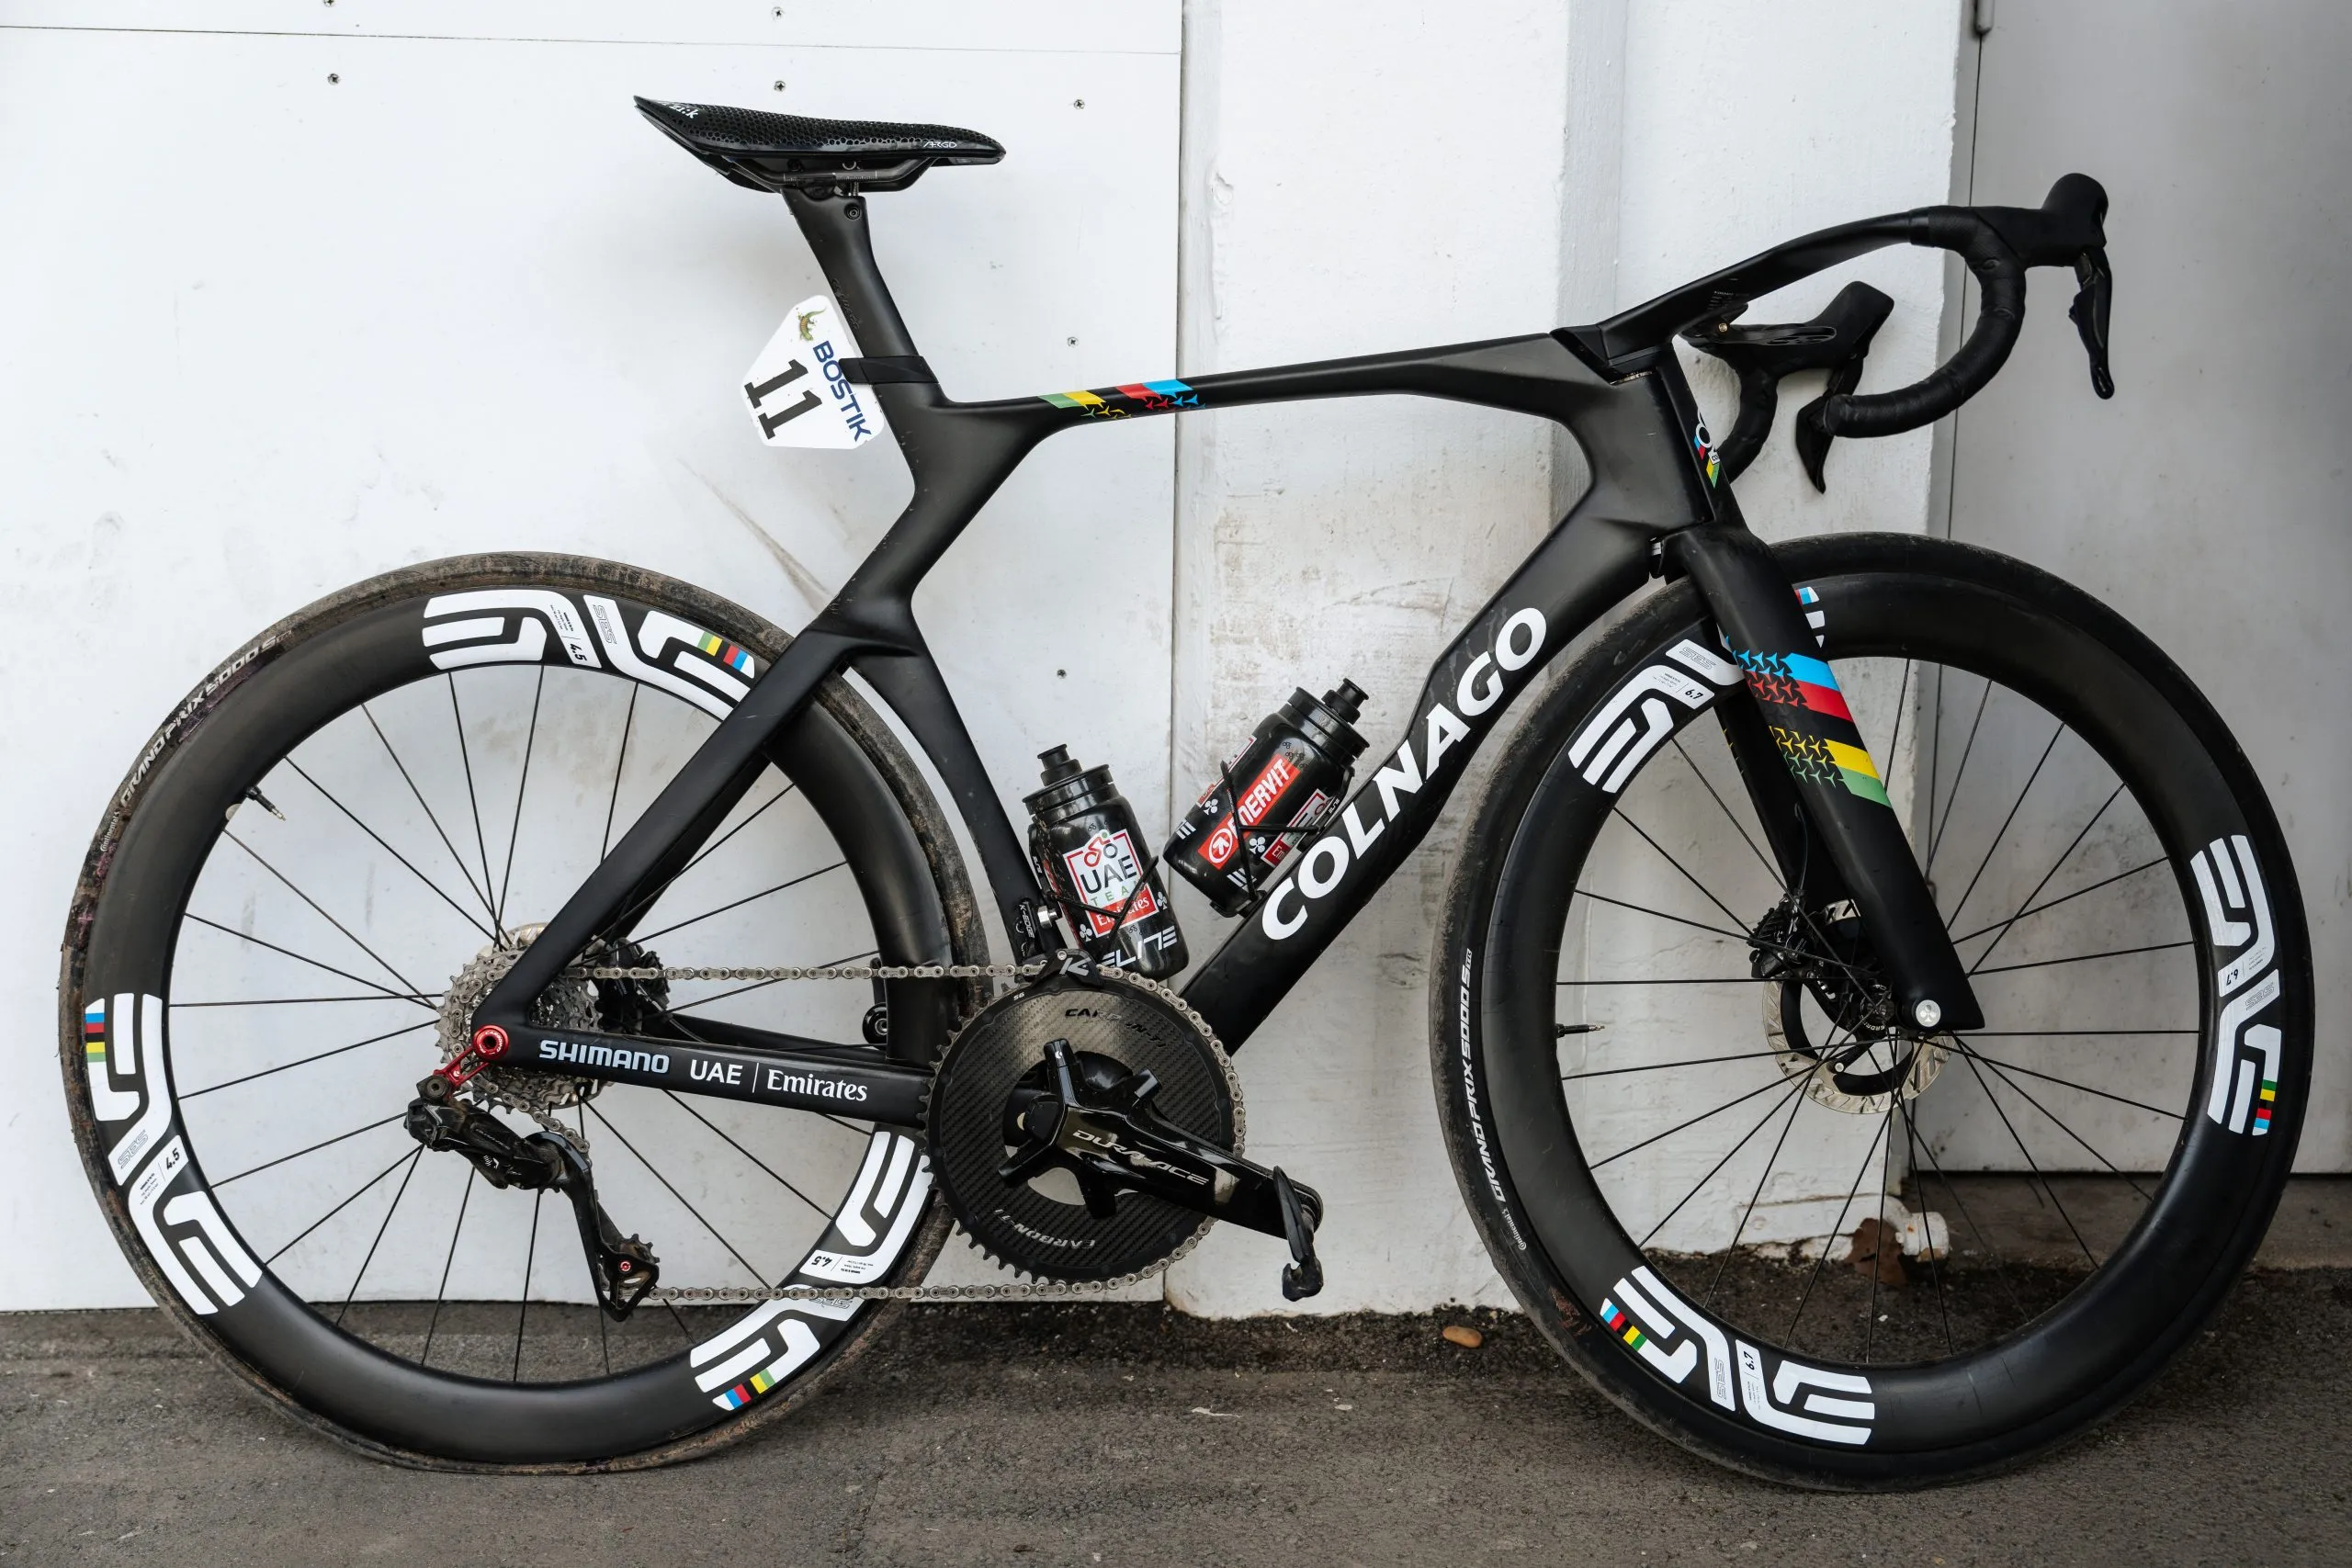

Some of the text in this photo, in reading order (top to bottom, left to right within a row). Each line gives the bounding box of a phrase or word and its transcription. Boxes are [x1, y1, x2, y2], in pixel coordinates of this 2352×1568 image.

[743, 358, 823, 440] 11
[812, 340, 872, 442] BOSTIK
[592, 604, 618, 645] SES
[569, 642, 588, 663] 4.5
[1678, 646, 1720, 671] SES
[1684, 686, 1704, 701] 6.7
[100, 816, 119, 852] Continental
[120, 736, 166, 807] GRAND
[165, 690, 205, 739] PRIX
[205, 646, 259, 696] 5000
[1261, 607, 1547, 941] COLNAGO
[1080, 854, 1137, 894] UAE
[1091, 880, 1138, 907] TEA
[1019, 904, 1035, 938] K-EDGE
[1013, 992, 1024, 1001] 56
[2225, 967, 2239, 987] 6.7
[1065, 1008, 1166, 1048] CARBN-TI
[1460, 985, 1472, 1061] 5000
[539, 1039, 670, 1074] SHIMANO
[689, 1058, 868, 1101] UAE Emirates
[1462, 1058, 1481, 1122] PRIX
[164, 1147, 181, 1170] 4.5
[1072, 1129, 1210, 1185] DURA-ACE
[1472, 1121, 1507, 1202] GRAND
[993, 1209, 1096, 1249] CARBON-TI
[1504, 1213, 1528, 1251] Continental
[810, 1255, 833, 1269] 4.5
[1743, 1350, 1756, 1371] 6.7
